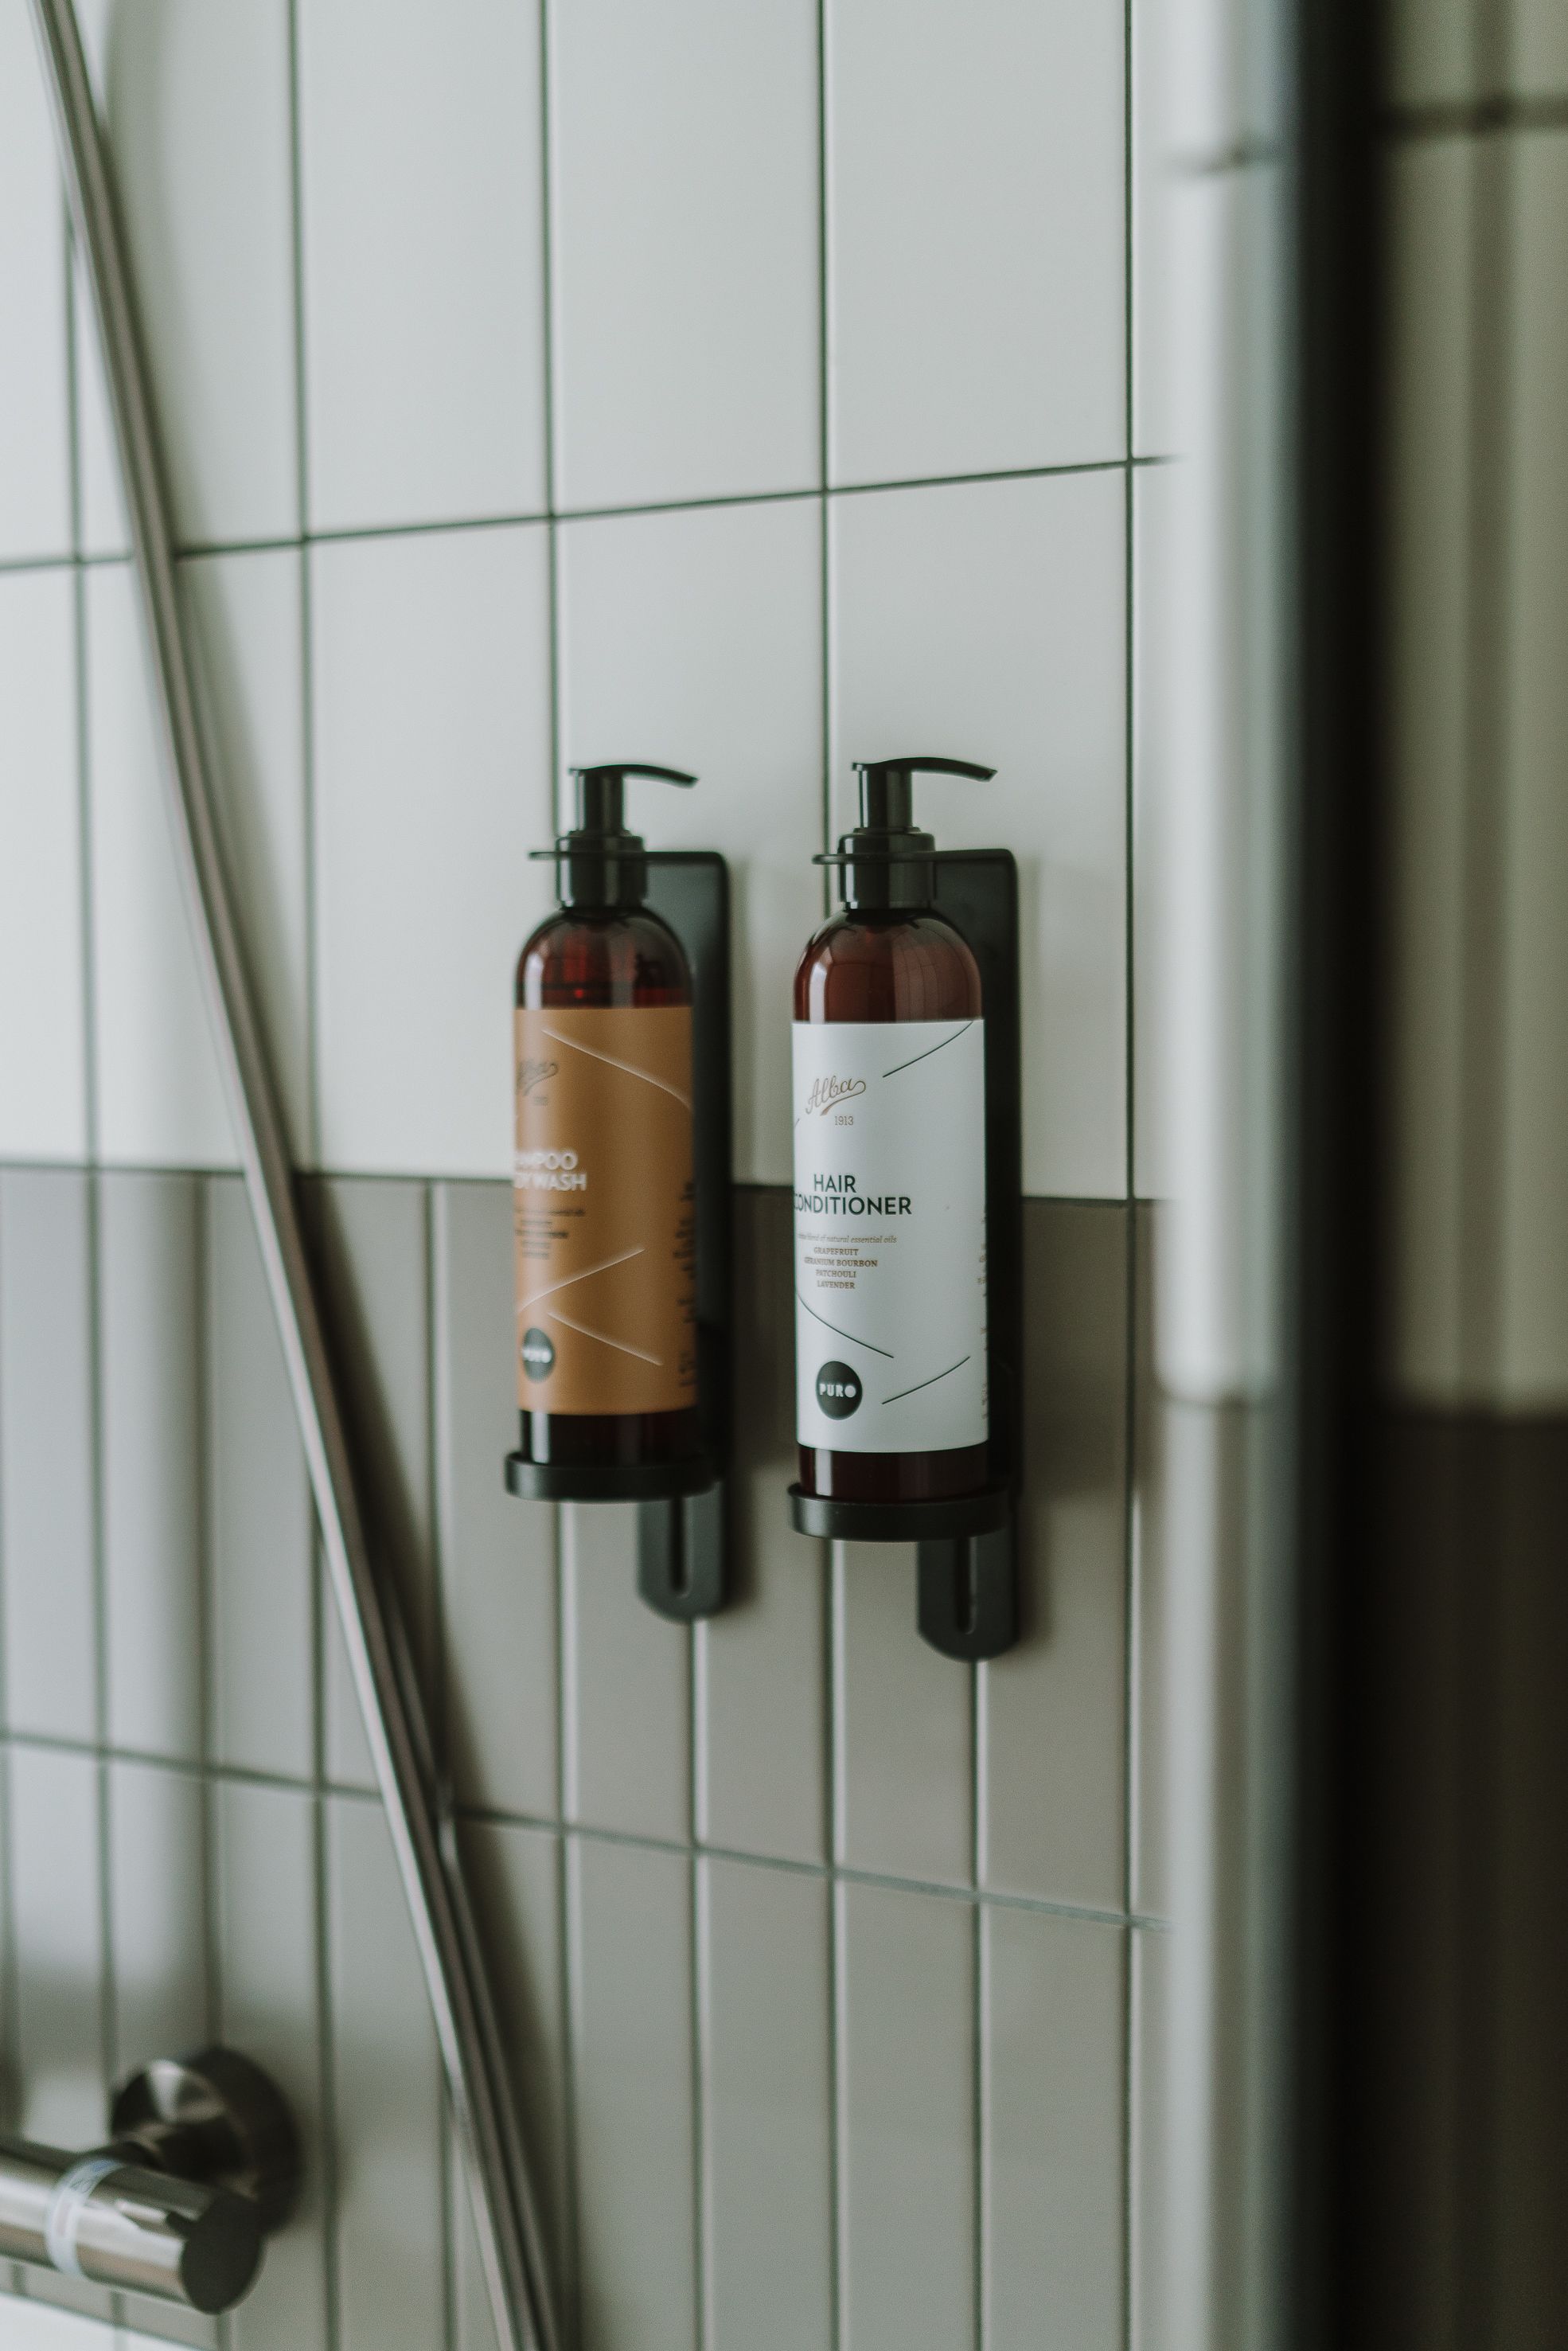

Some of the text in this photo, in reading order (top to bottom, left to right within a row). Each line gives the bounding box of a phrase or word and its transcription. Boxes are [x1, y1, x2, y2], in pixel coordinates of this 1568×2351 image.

[805, 1076, 866, 1115] Alba
[835, 1116, 854, 1126] 1913
[813, 1174, 856, 1193] HAIR
[816, 1269, 856, 1278] PATCHOULI
[817, 1280, 856, 1289] LAVENDER
[819, 1384, 856, 1398] PURO
